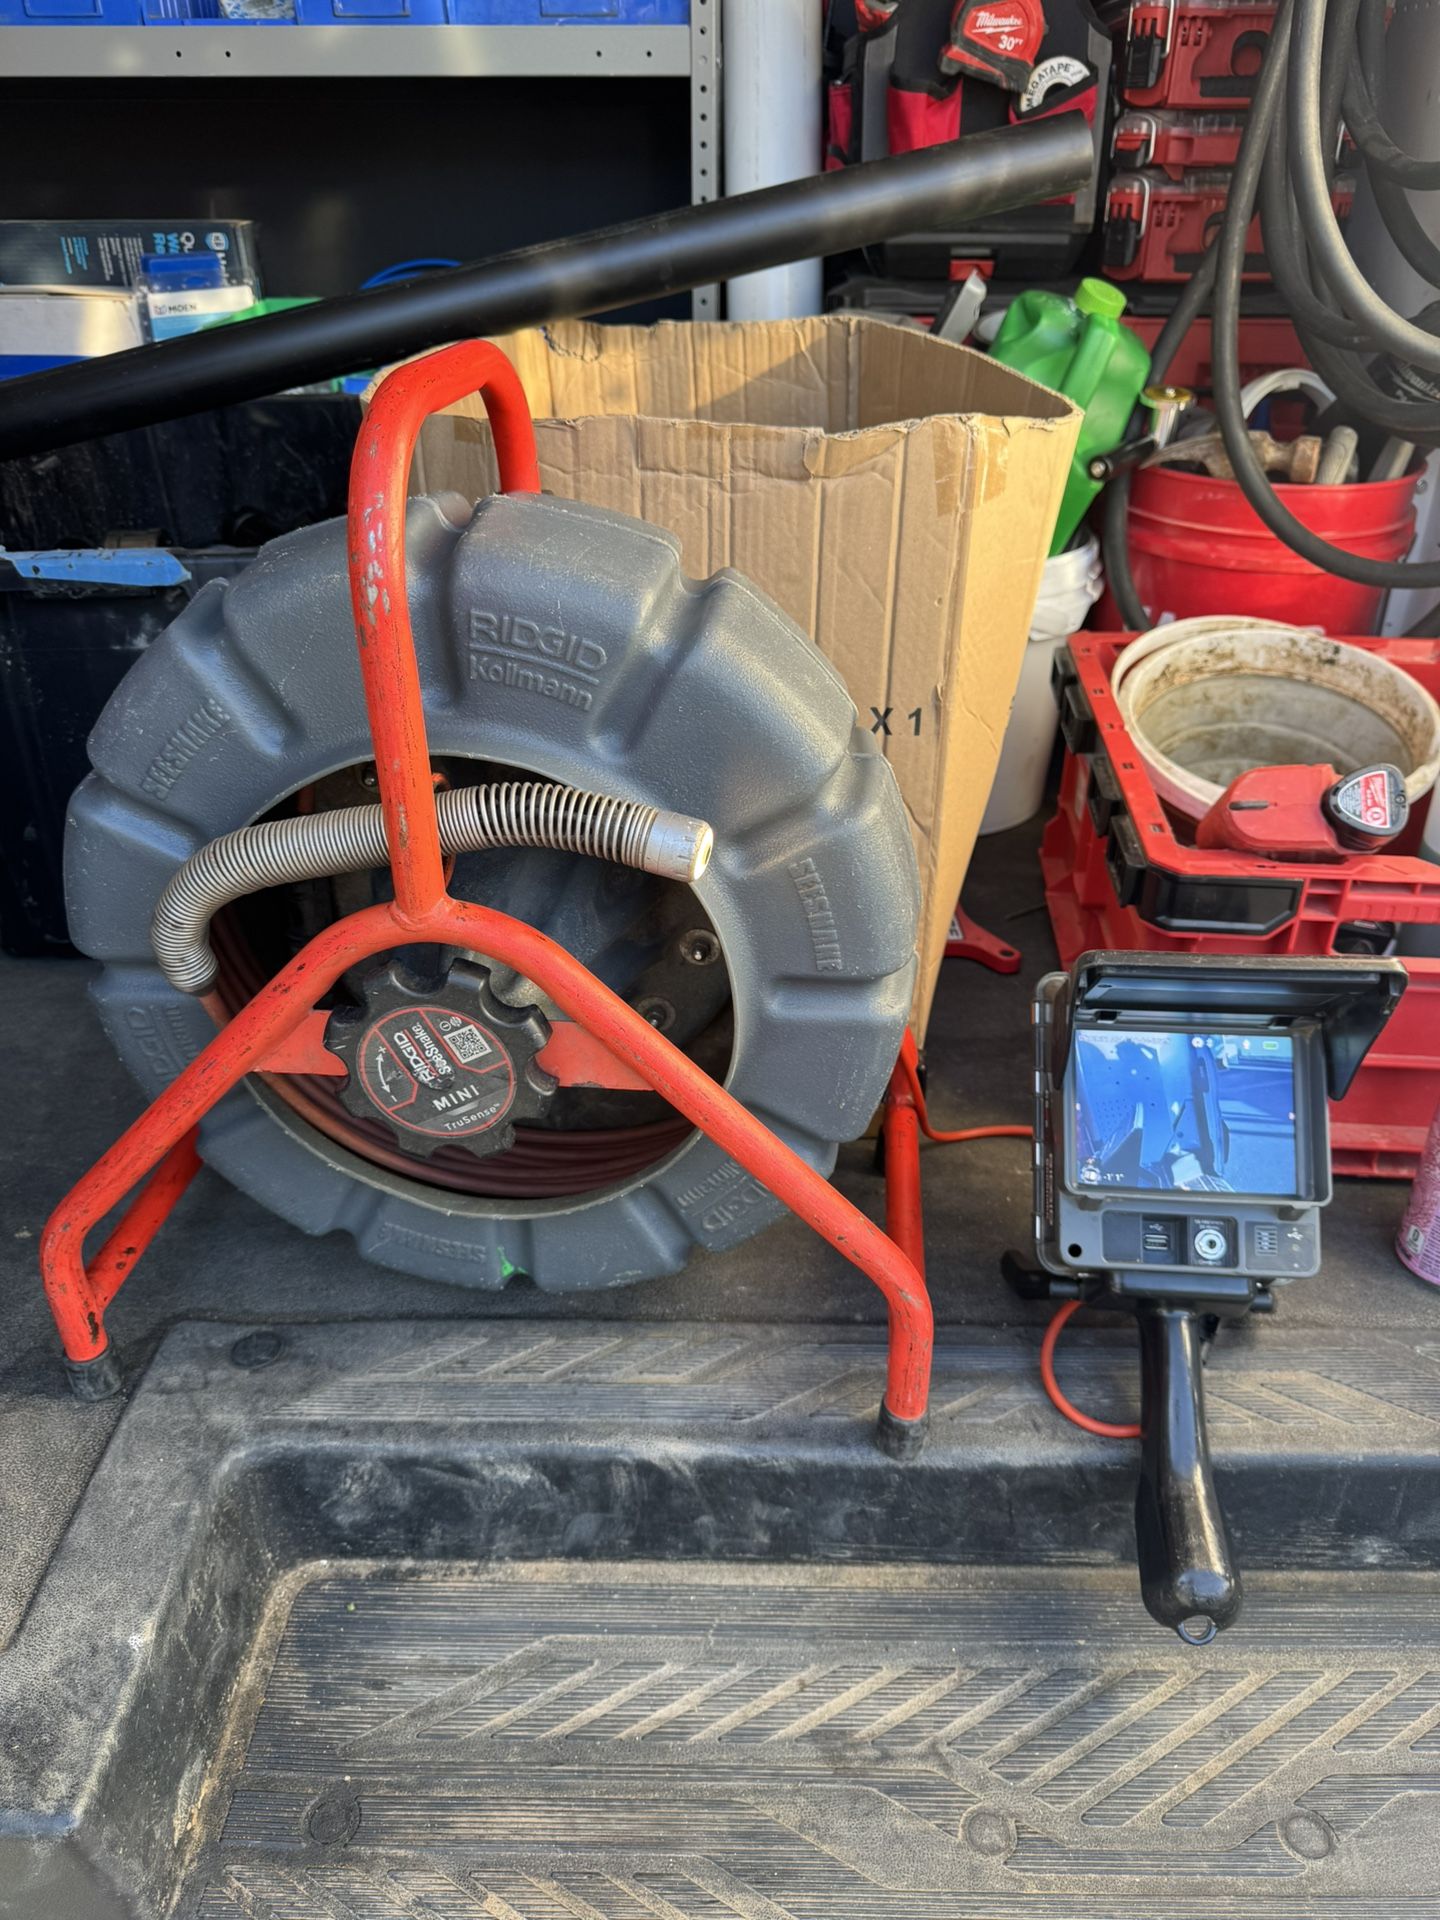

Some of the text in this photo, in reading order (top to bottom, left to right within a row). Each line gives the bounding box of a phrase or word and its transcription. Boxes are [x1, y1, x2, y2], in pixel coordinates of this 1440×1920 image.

[975, 11, 1023, 28] Milwaukee
[469, 609, 608, 672] RIDGID
[469, 653, 593, 711] Kollmann
[908, 707, 923, 736] 1
[394, 1032, 434, 1082] RIDGID
[412, 1023, 452, 1075] SeeSnake
[432, 1084, 480, 1111] MINI
